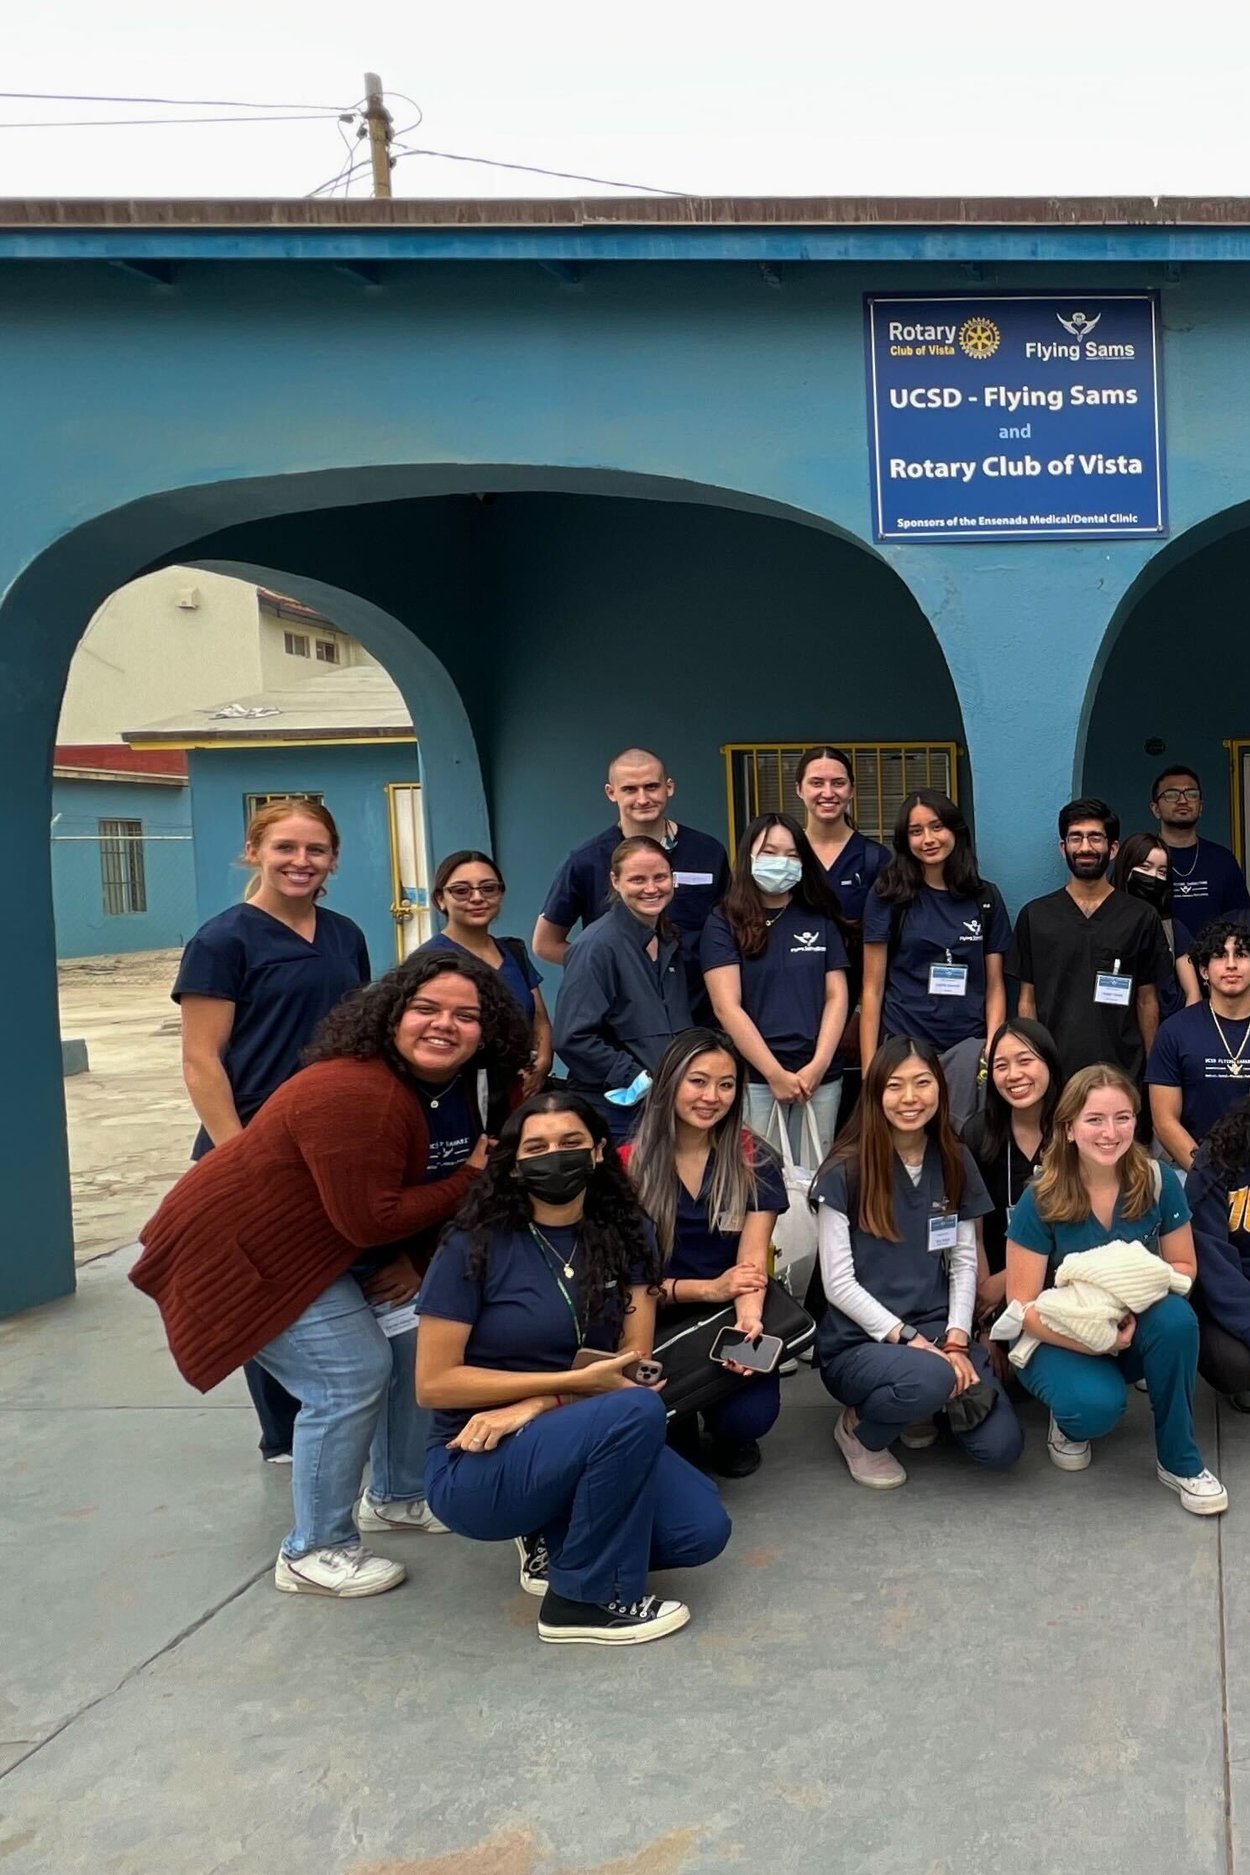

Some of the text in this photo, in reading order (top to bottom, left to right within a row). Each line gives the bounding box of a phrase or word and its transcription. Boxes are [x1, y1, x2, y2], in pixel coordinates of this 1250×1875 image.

[890, 322, 956, 344] Rotary
[890, 344, 955, 356] Club of Vista
[1026, 341, 1135, 361] Flying Sams
[889, 388, 962, 408] UCSD
[984, 386, 1064, 411] Flying
[1070, 385, 1138, 405] Sams
[998, 423, 1032, 439] and
[890, 453, 1143, 482] Rotary Club of Vista
[897, 513, 1138, 528] Sponsors of the Ensenada Medical/Dental Clinic
